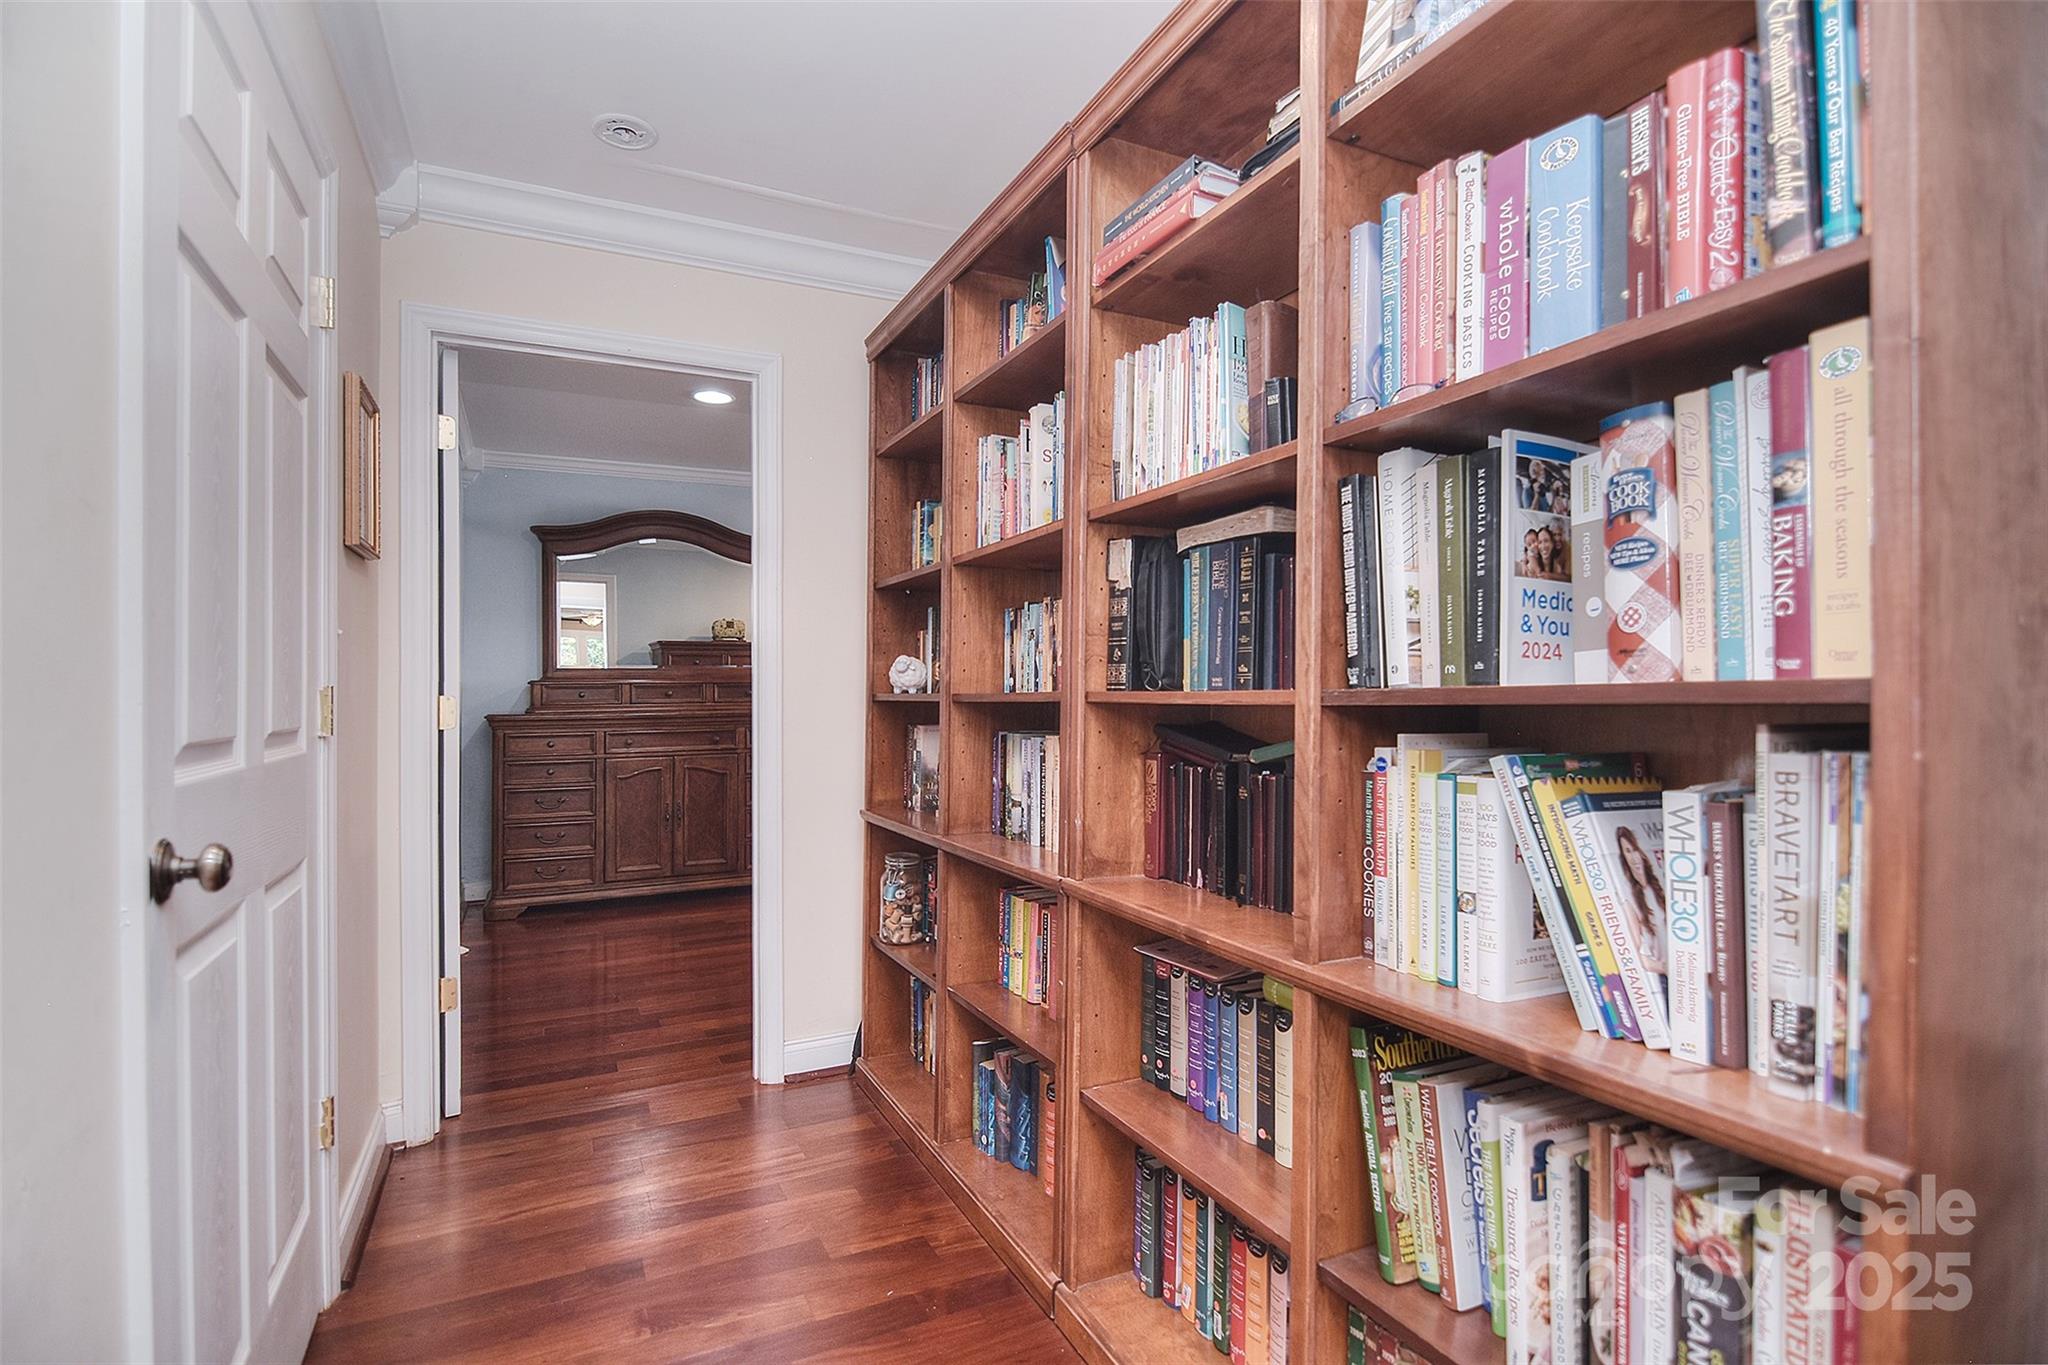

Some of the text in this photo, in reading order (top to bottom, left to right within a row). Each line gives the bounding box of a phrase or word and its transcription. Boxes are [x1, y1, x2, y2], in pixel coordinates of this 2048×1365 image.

[1769, 34, 1797, 95] Southern
[1630, 105, 1650, 177] HERSHEY'S
[1767, 94, 1799, 144] Living
[1825, 17, 1845, 213] 40 Years of Our Best Recipes
[1675, 103, 1693, 241] Gluten-Free BIBLE
[1709, 134, 1740, 196] Quick
[1536, 206, 1560, 304] Cookbook
[1558, 195, 1591, 292] Keepsake
[1708, 206, 1738, 249] Easy
[1462, 178, 1476, 370] Betty COOKING BASICS
[1498, 197, 1520, 341] whole FOOD
[1709, 250, 1738, 270] 2
[1381, 217, 1400, 396] Cooking Light five star recipes
[1417, 235, 1430, 349] Homestyle Cookbook
[1433, 234, 1446, 352] Homestyle Cooking
[1489, 288, 1498, 341] RECIPES
[1833, 385, 1853, 406] all
[1828, 411, 1855, 479] through
[1421, 481, 1432, 543] Magnolia Table
[1442, 478, 1454, 516] Magnolia
[1476, 468, 1487, 534] MAGNOLIA
[1609, 480, 1650, 502] COOK
[1610, 493, 1649, 513] BOOK
[1834, 485, 1856, 512] the
[1191, 552, 1200, 575] BIBLE
[1211, 560, 1220, 591] BIBLE
[1340, 484, 1359, 658] THE MOST SCENIC DRIVES AMERICA
[1476, 538, 1486, 577] TABLE
[1582, 531, 1592, 578] recipes
[1727, 539, 1742, 588] SUPER
[1771, 513, 1796, 617] BAKING
[1834, 517, 1853, 579] seasons
[1521, 614, 1570, 637] & You
[1522, 588, 1573, 612] Medic
[1683, 552, 1696, 653] REE DRUMMOND
[1694, 553, 1706, 649] DINNER'S READY!
[1719, 572, 1730, 639] DRUMMOND
[1521, 641, 1562, 661] 2024
[1376, 776, 1387, 799] BEST
[1362, 779, 1375, 918] Martha Stewart's COOKIES
[1498, 767, 1539, 875] LIBERTY MATHEMATICS Level
[1547, 803, 1583, 885] INTRODUCING MATH
[1711, 822, 1723, 859] BAKER'S
[1572, 820, 1606, 892] WHOLE30
[1668, 804, 1700, 943] WHOLE30
[1774, 770, 1800, 946] BRAVETART
[1713, 862, 1725, 919] CHOCOLATE
[1585, 911, 1600, 940] GRADE
[1463, 943, 1471, 974] LEAKE
[1674, 949, 1686, 1015] Dallas Hartwig
[1686, 951, 1699, 1023] Melissa Hartwig
[1771, 1000, 1785, 1040] PARKS
[1784, 1000, 1798, 1043] STELLA
[1420, 1088, 1436, 1136] WHEAT
[1364, 1131, 1383, 1213] ANNUAL RECIPES
[1406, 1151, 1419, 1201] EVERYDAY
[1424, 1137, 1439, 1176] BELLY
[1482, 1149, 1493, 1170] THE
[1430, 1177, 1443, 1238] COOKBOOK
[1484, 1171, 1495, 1207] MAYO
[1411, 1202, 1424, 1254] PRODUCTS
[1486, 1208, 1498, 1249] CLINIC
[1506, 1186, 1520, 1327] Treasured Recipes
[1785, 1199, 1812, 1365] ILLUSTRATED
